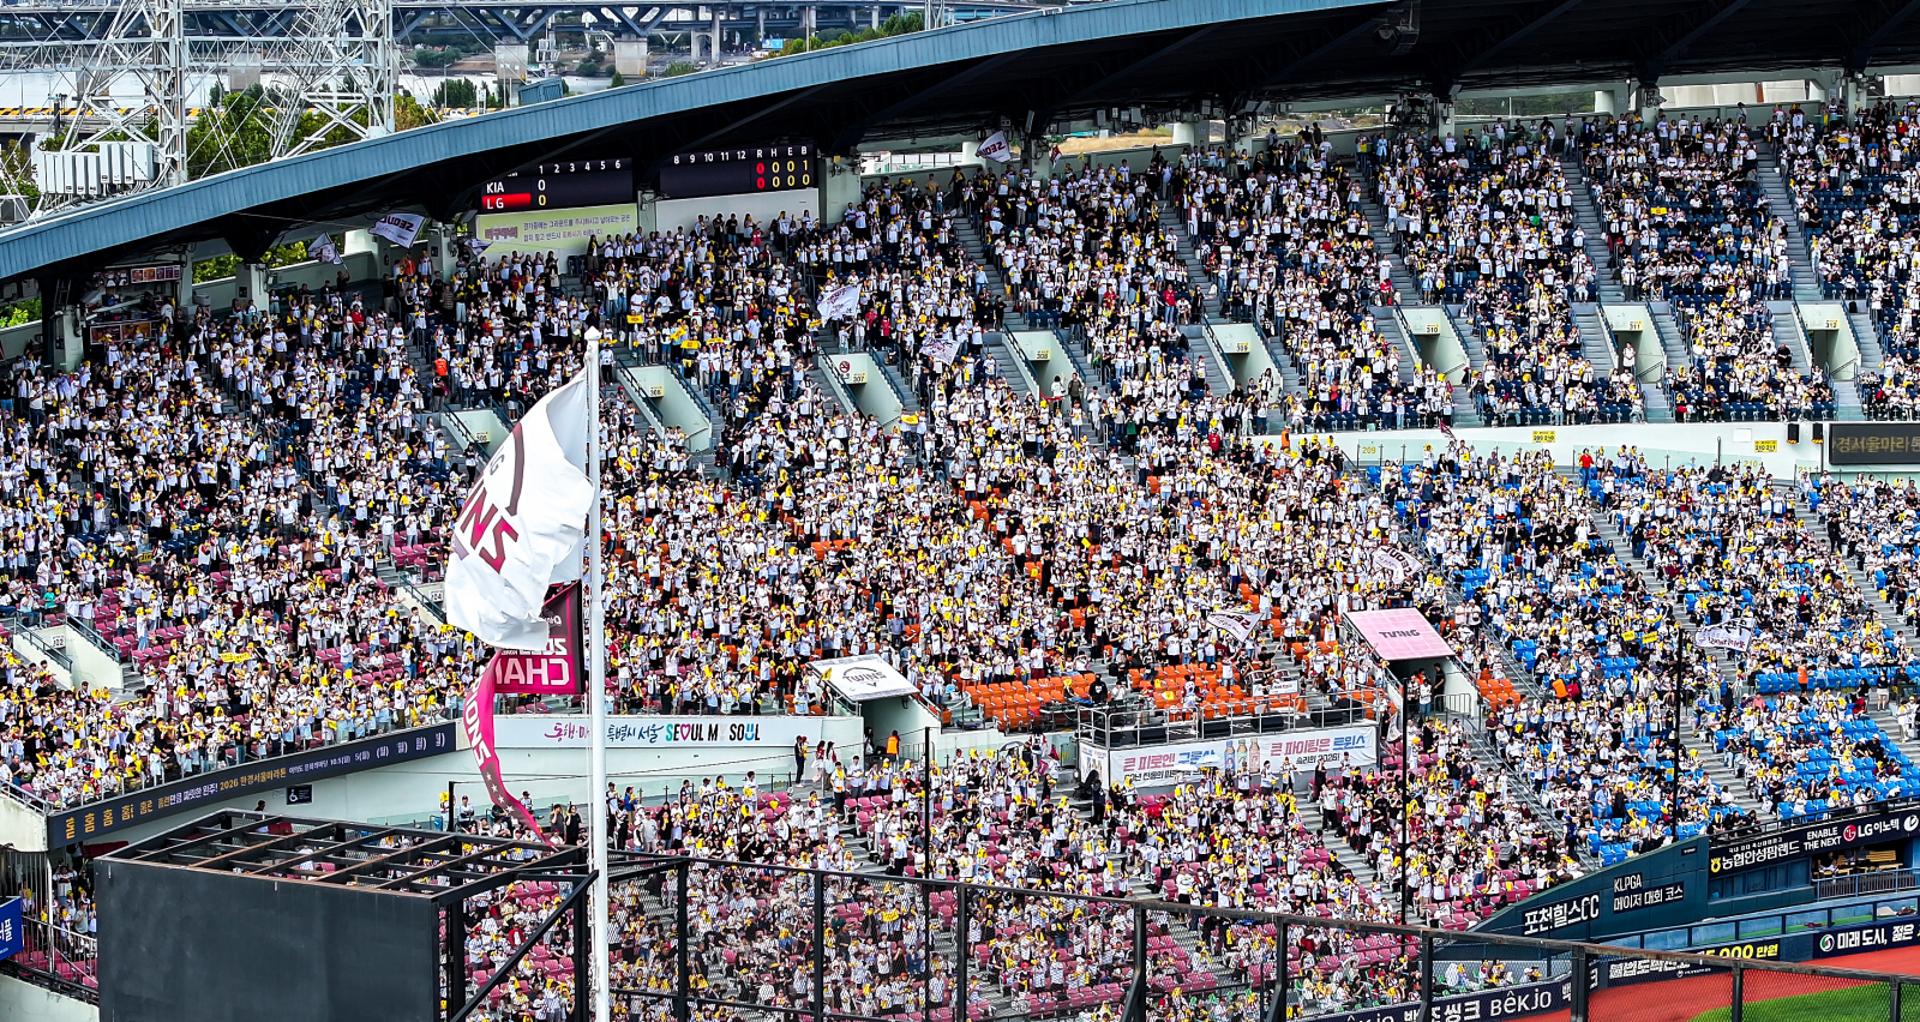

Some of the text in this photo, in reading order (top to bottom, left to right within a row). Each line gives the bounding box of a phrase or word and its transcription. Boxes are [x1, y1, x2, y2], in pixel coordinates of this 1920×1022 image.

[674, 146, 807, 164] 8 9 10 11 12 R H E B
[539, 160, 620, 174] 1 2 3 4 5 6
[756, 160, 808, 174] 0 0 0 1
[486, 180, 545, 193] KIA 0
[757, 174, 809, 189] 0 0 0 0
[538, 195, 546, 205] 0
[606, 725, 636, 742] 특별시
[637, 724, 665, 743] 서울
[729, 723, 760, 742] SOUL
[1333, 735, 1366, 751] 트윈스
[1803, 826, 1843, 851] ENABLE THE NEXT
[1722, 840, 1800, 870] 농협안성팜랜드
[1613, 873, 1642, 893] KLPGA
[1613, 885, 1684, 912] 메이저 대회 코스
[1524, 894, 1600, 936] 포천힐스CC
[1837, 923, 1915, 950] 미래 도시, 젊은
